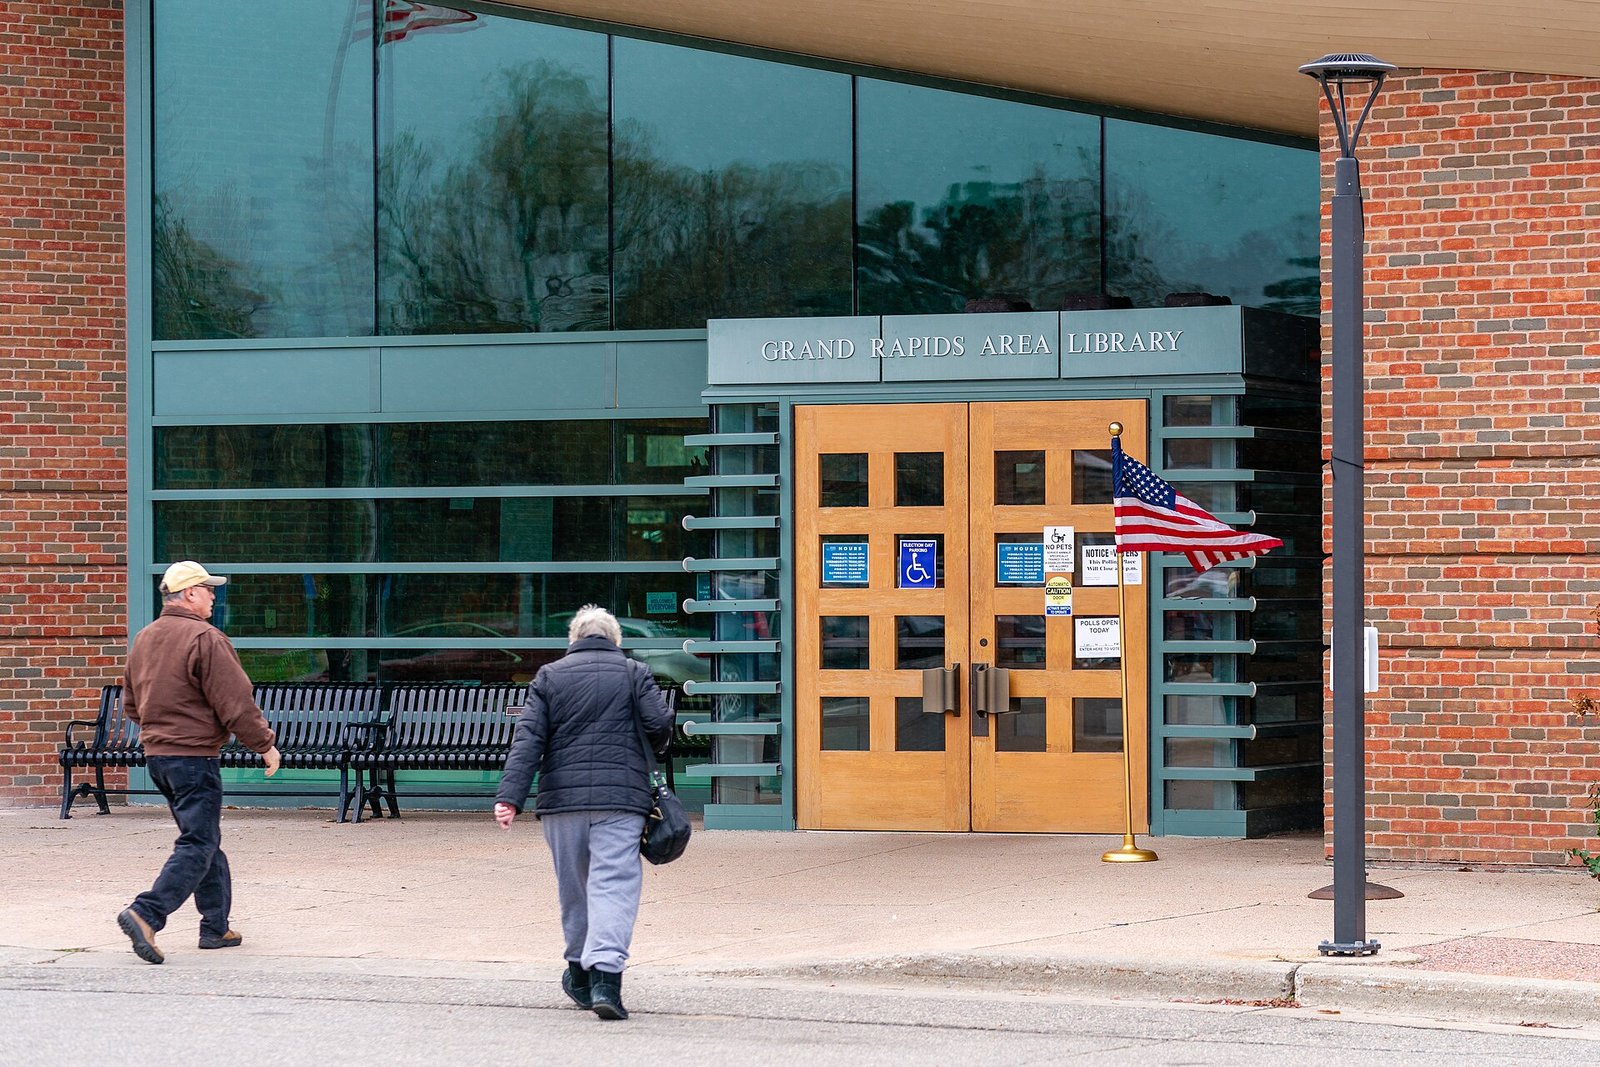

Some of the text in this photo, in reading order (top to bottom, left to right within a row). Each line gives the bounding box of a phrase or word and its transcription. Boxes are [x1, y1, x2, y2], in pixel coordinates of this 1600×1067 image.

[761, 330, 1183, 361] GRAND RAPIDS AREA LIBRARY
[1086, 549, 1109, 557] NOTICE
